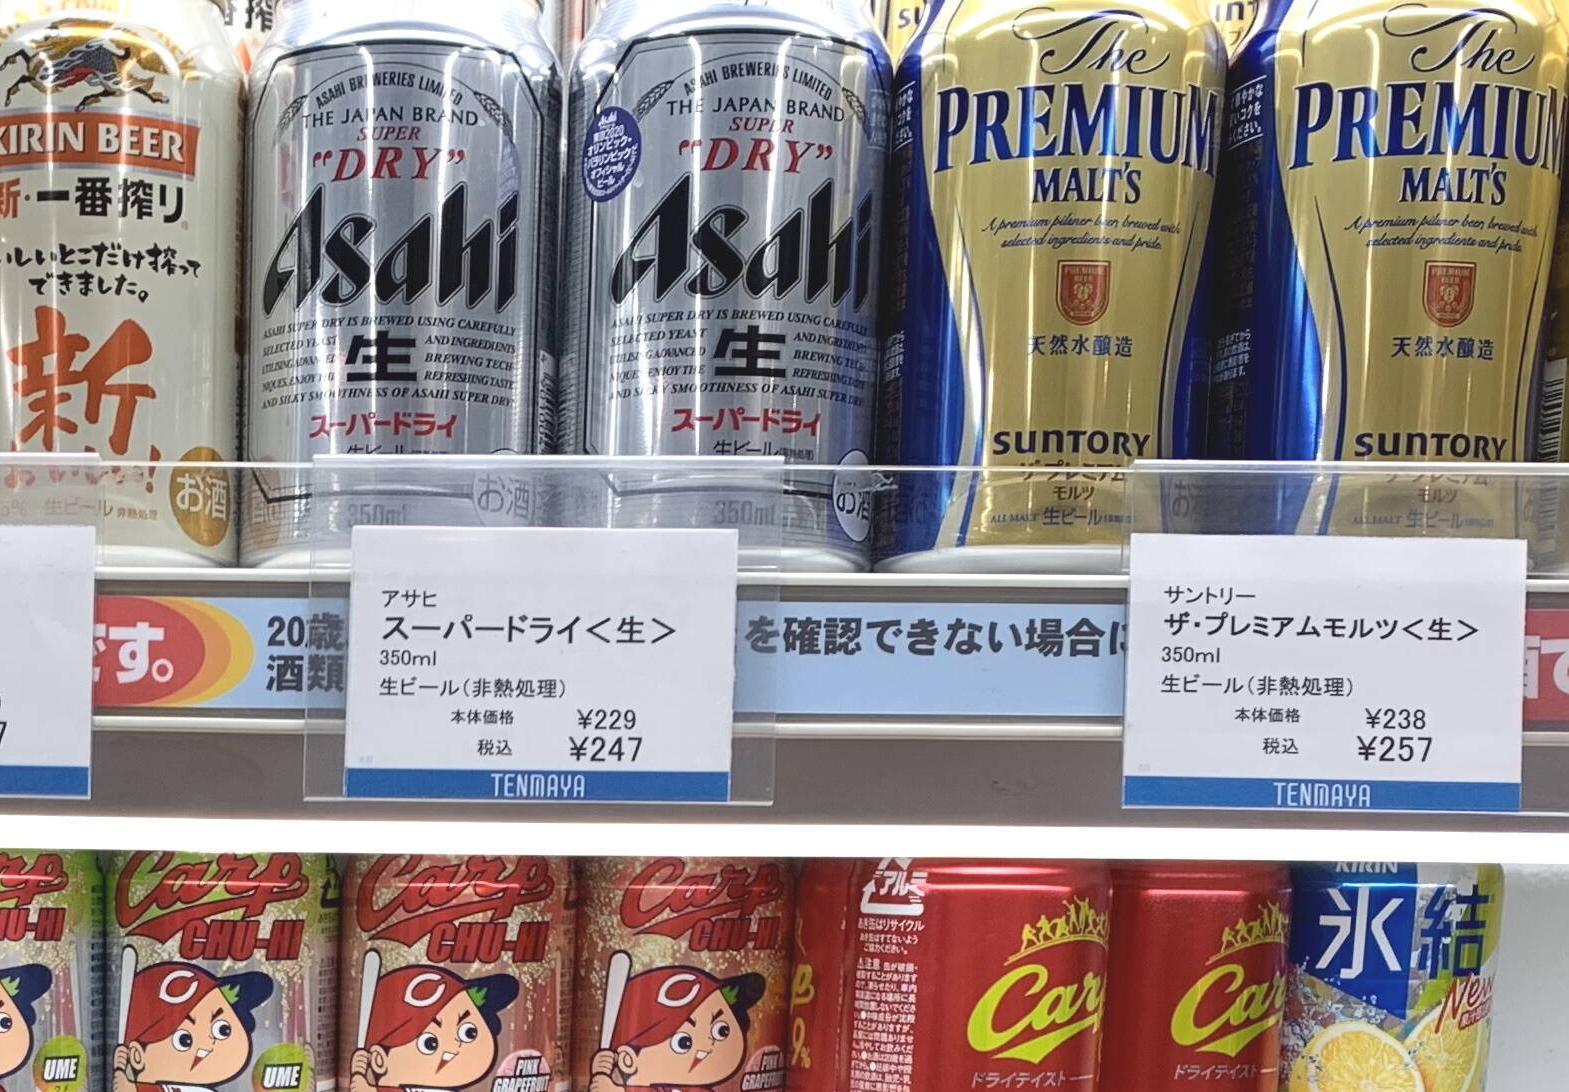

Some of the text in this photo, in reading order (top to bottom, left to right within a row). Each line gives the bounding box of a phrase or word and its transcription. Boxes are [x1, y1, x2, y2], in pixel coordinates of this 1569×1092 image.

[787, 100, 845, 122] BRAND
[97, 122, 184, 162] BEER
[932, 80, 1217, 178] PREMIUM
[1287, 80, 1567, 178] PREMIUM
[1032, 167, 1142, 206] MALT'S
[1399, 166, 1506, 206] MALT'S
[263, 181, 519, 314] Asahi
[611, 174, 873, 313] Asahi
[345, 330, 417, 382] 生
[713, 326, 786, 378] 生
[1028, 335, 1133, 357] 天然水醸造
[1391, 336, 1494, 360] 天然水醸造
[6, 305, 156, 455] 新
[308, 411, 458, 438] スーパードライ
[671, 407, 821, 437] スーパードライ
[993, 430, 1150, 456] SUNTORY
[1354, 432, 1507, 461] SUNTORY
[177, 470, 229, 521] お酒
[381, 588, 438, 609] アサヒ
[1164, 585, 1257, 605] サントリー
[379, 648, 437, 667] 350ml
[1161, 646, 1220, 665] 350ml
[379, 677, 568, 700] 生ビール(非熱処理)
[1161, 674, 1355, 698] 生ビール(非熱処理)
[450, 708, 637, 731] 本体価格 ¥229
[1234, 707, 1427, 730] 本体価格 ¥238
[477, 735, 643, 763] 税込 ¥247
[1263, 736, 1433, 763] 税込 ¥257
[491, 773, 586, 798] TENMAYA
[1273, 783, 1372, 807] TENMAYA
[180, 920, 304, 961] CHU-HI
[428, 921, 549, 963] CHU-HI
[1316, 884, 1490, 980] 氷結
[43, 1058, 78, 1082] UME
[264, 1065, 299, 1089] UME
[971, 1071, 1067, 1089] ドライテイスト
[1174, 1064, 1259, 1081] ドライテイスト
